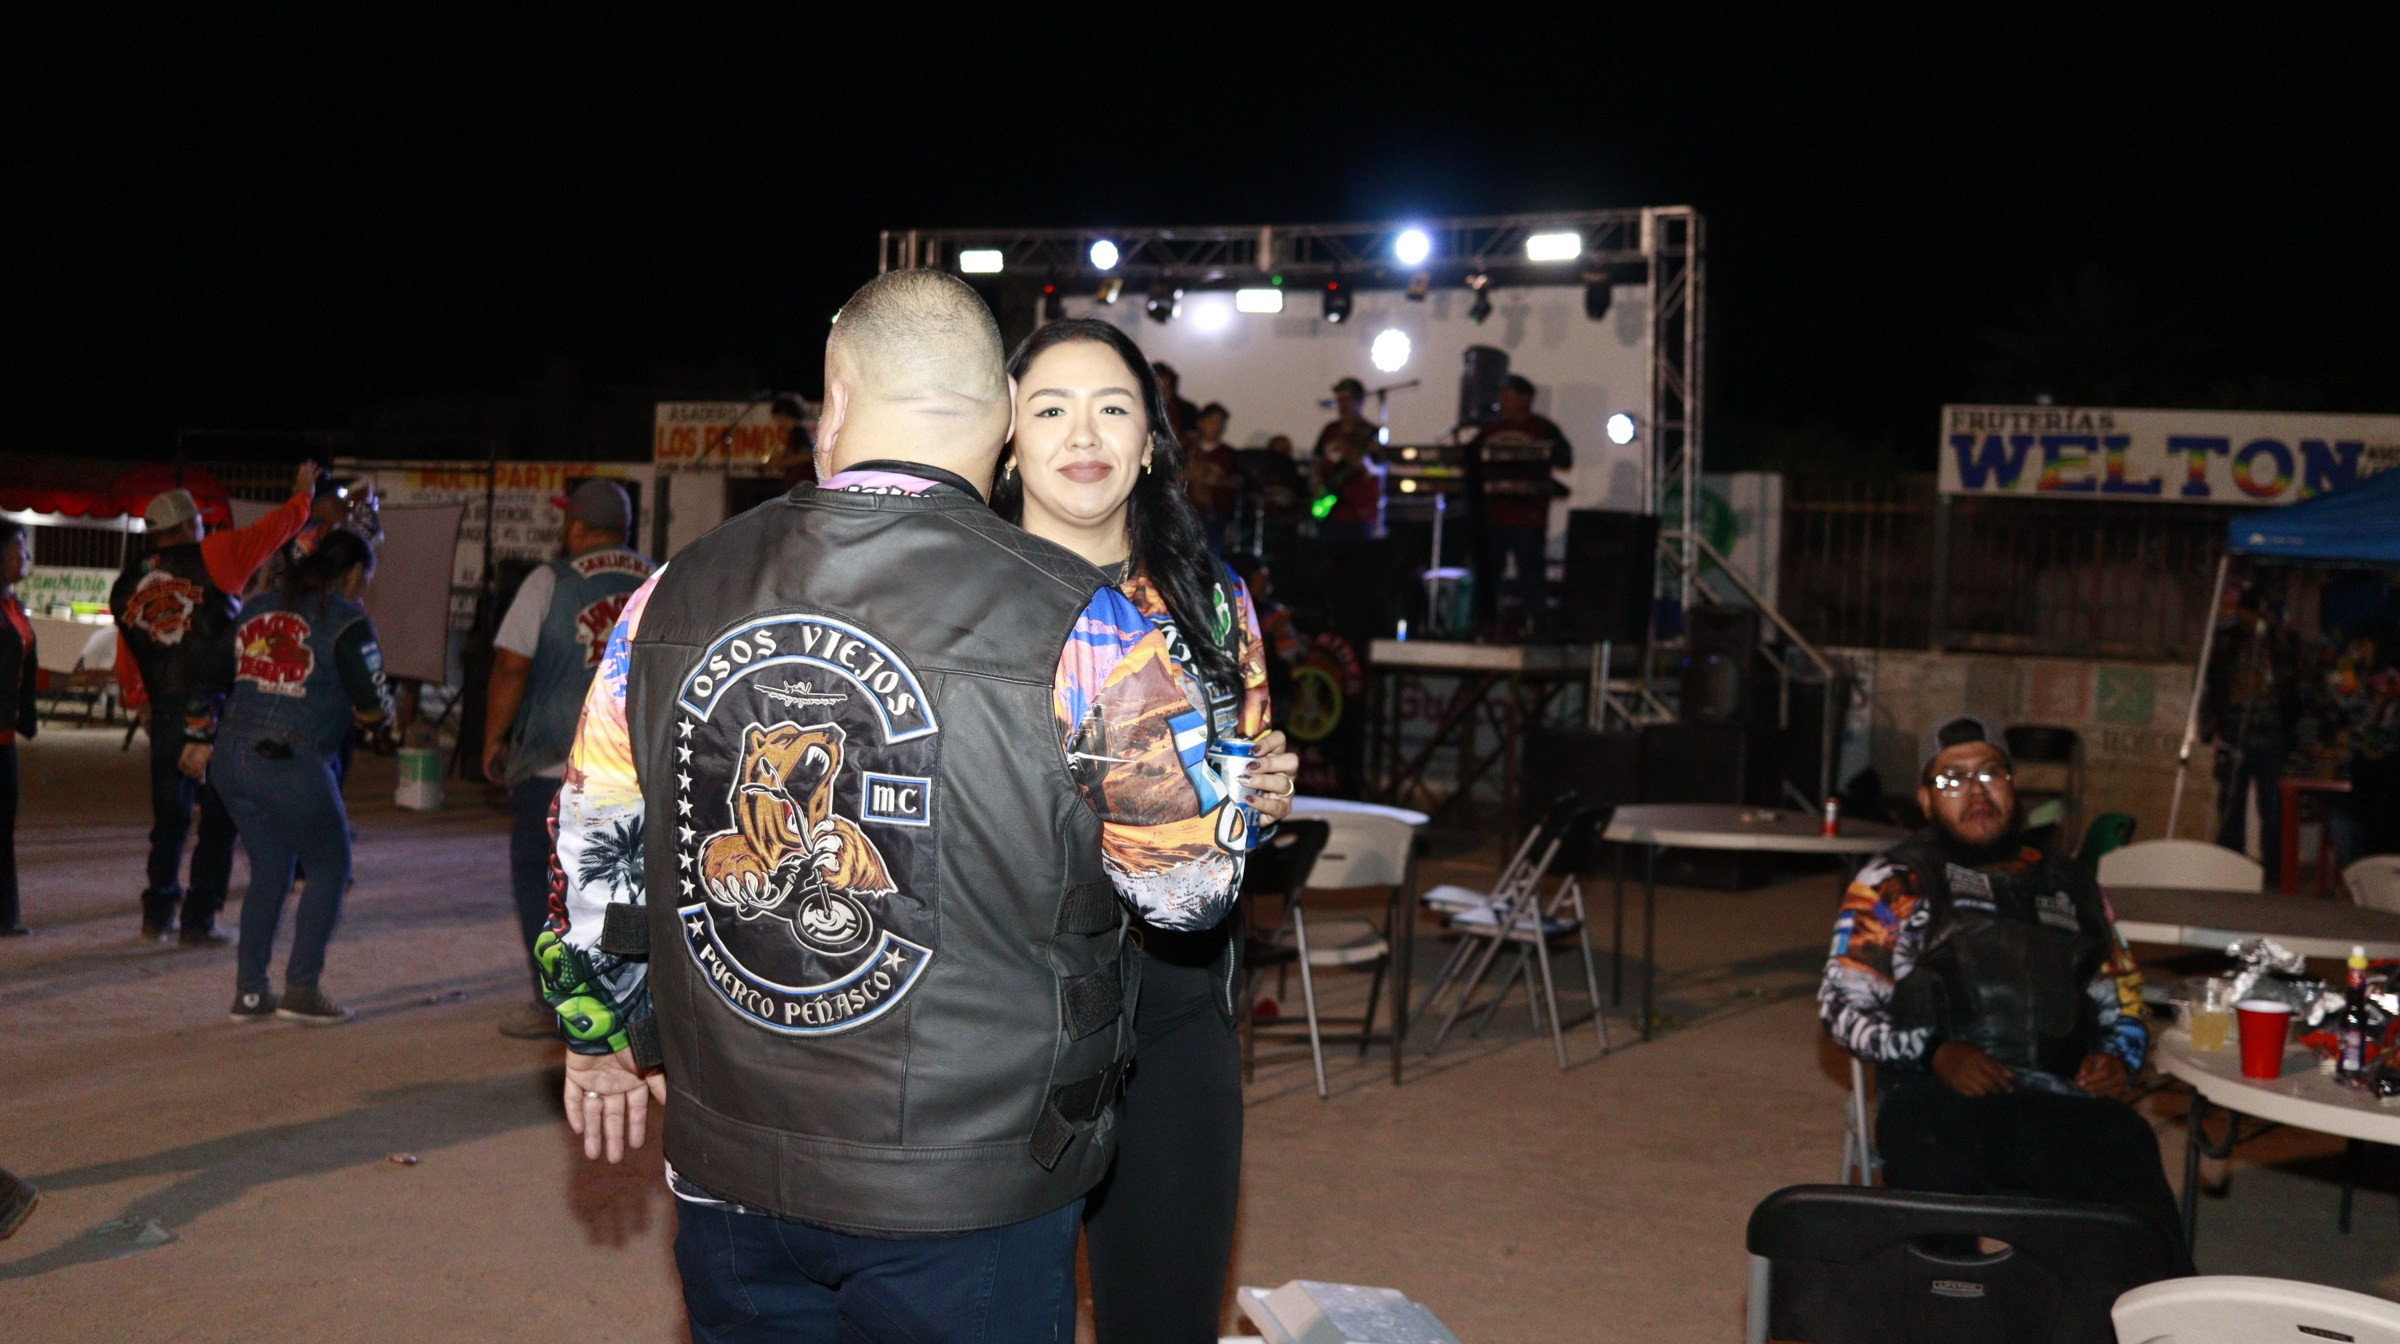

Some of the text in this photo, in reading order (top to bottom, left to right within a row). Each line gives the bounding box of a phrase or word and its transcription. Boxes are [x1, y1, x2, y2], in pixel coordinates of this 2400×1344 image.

[657, 424, 697, 459] LOS
[1950, 434, 2364, 499] WELTON
[693, 625, 916, 717] OSOS VIEJOS
[699, 942, 891, 1025] PUERTO PEÑASCO
